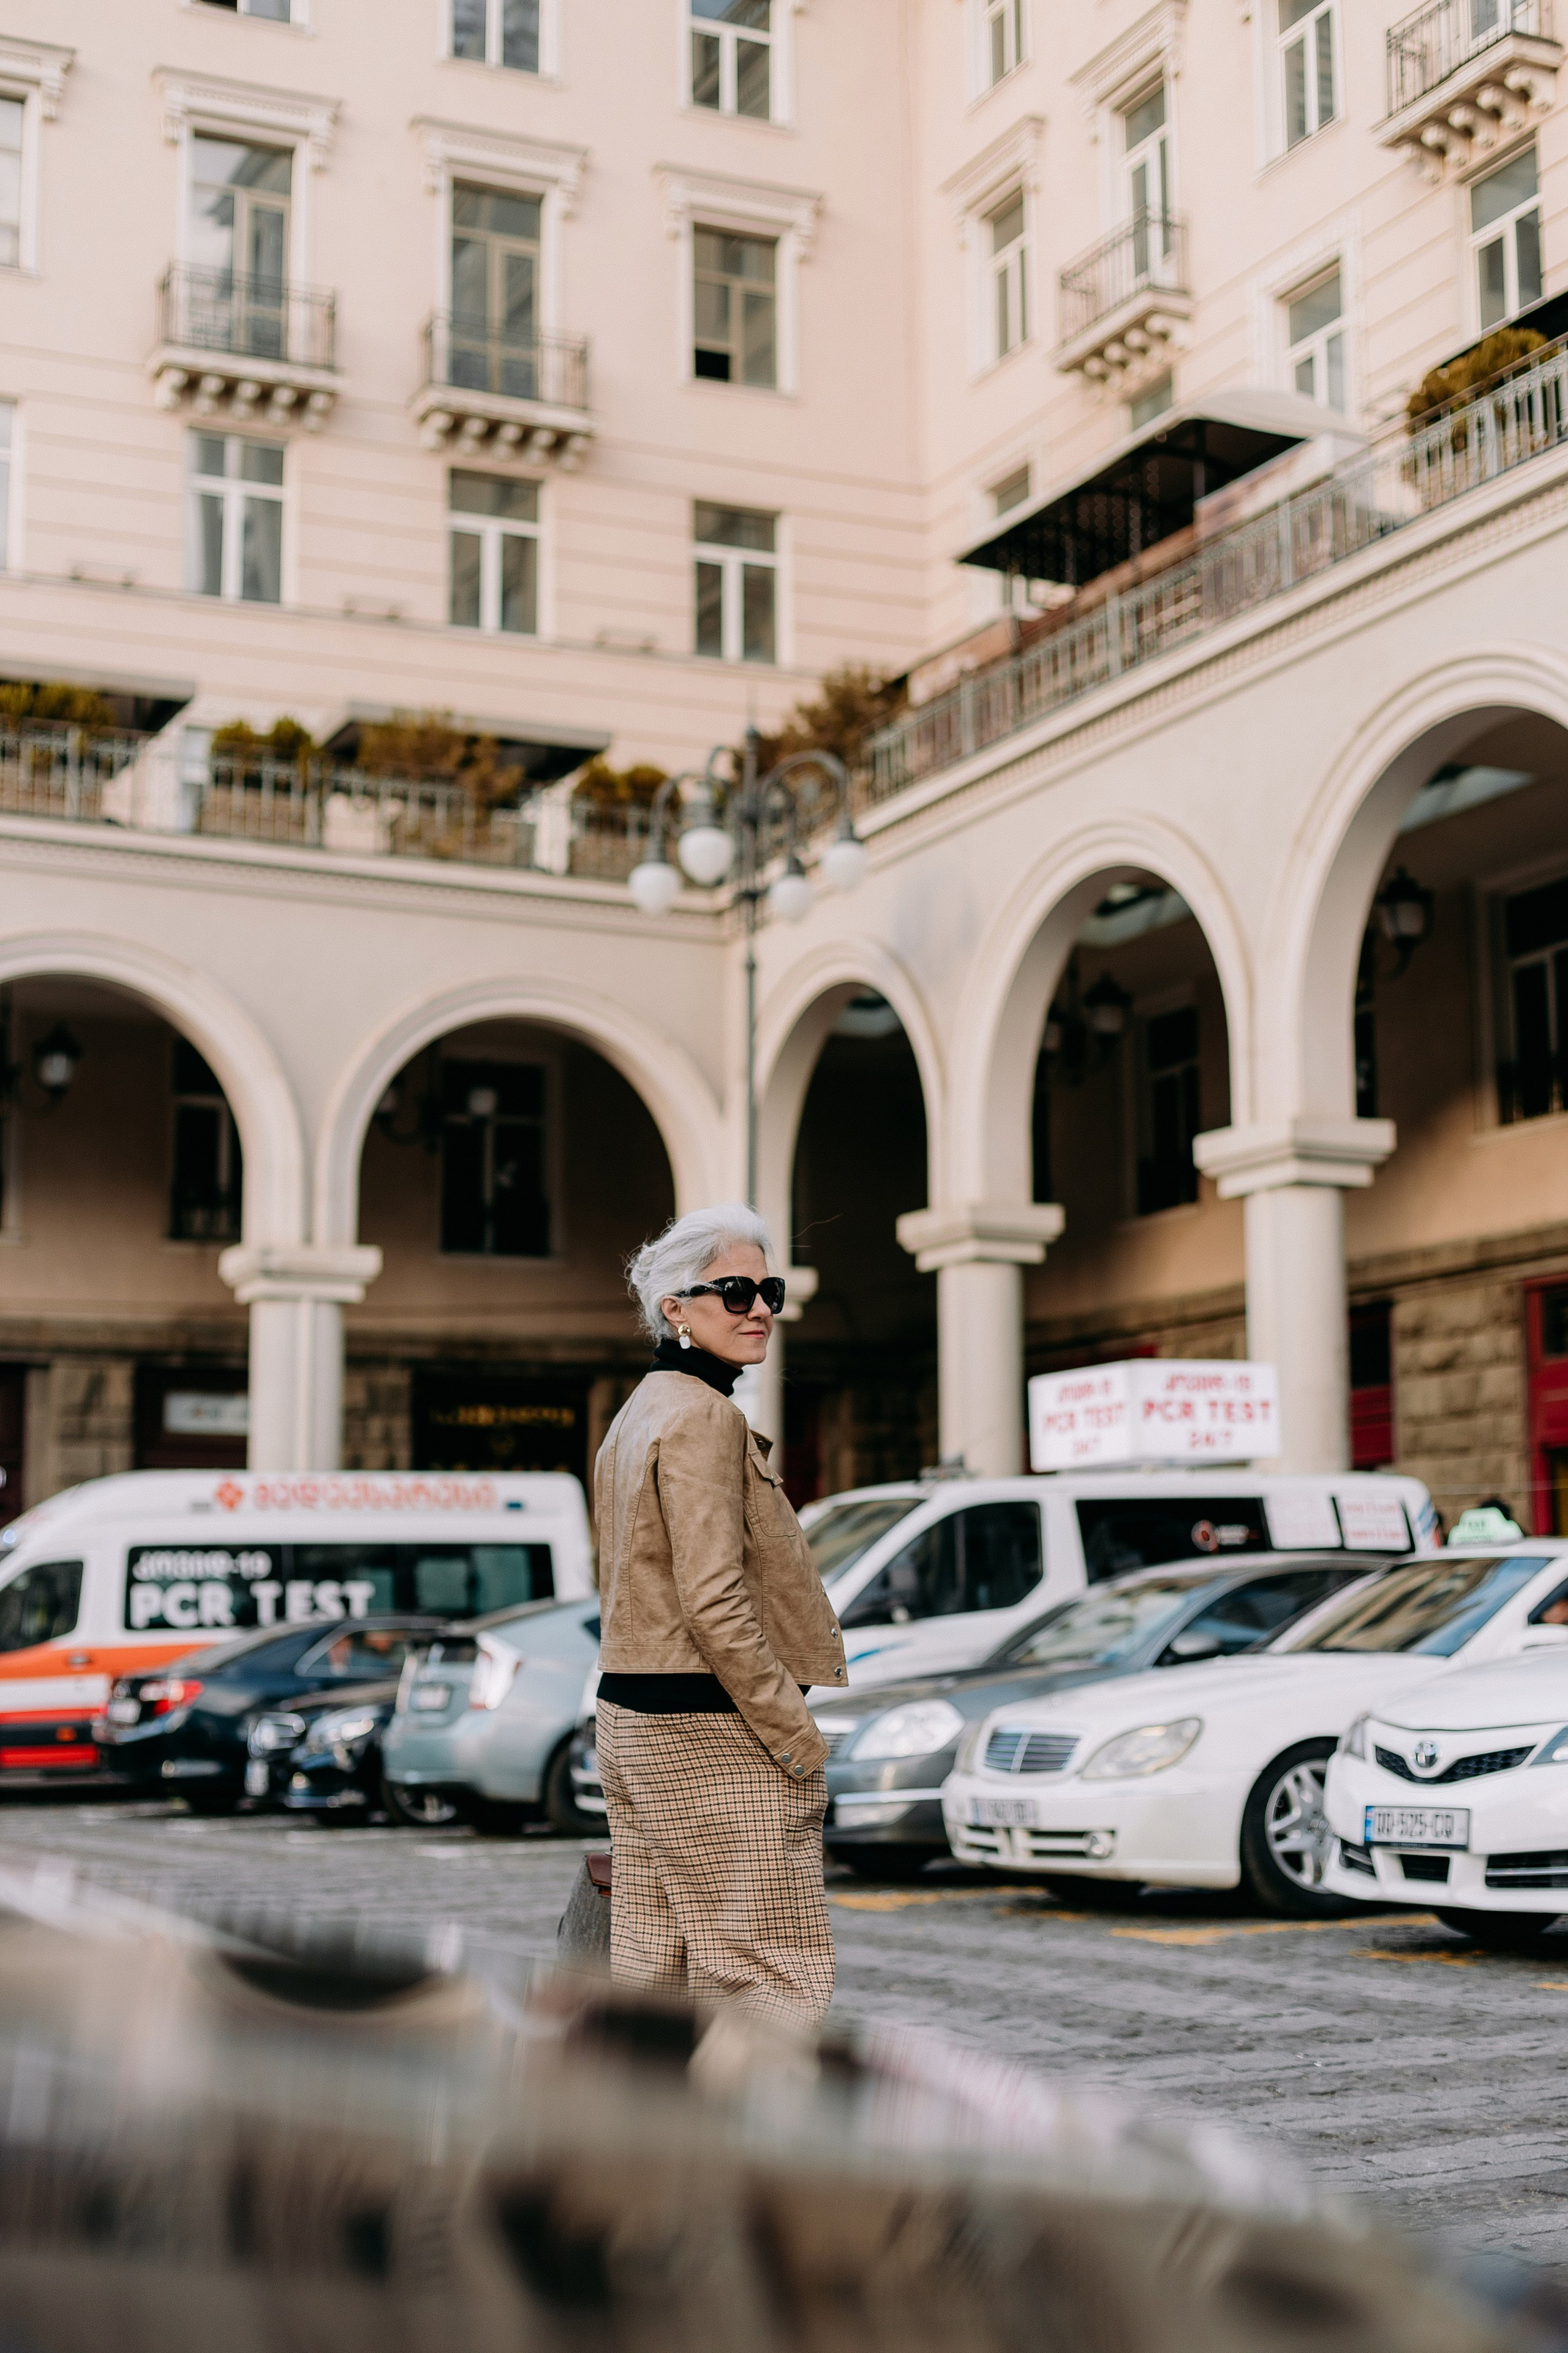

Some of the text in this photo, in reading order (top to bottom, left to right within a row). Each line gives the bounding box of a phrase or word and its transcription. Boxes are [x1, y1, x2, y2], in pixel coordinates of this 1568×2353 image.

[1043, 1401, 1125, 1433] PCR TEST
[1142, 1400, 1270, 1422] PCR TEST
[130, 1580, 375, 1628] PCR TEST
